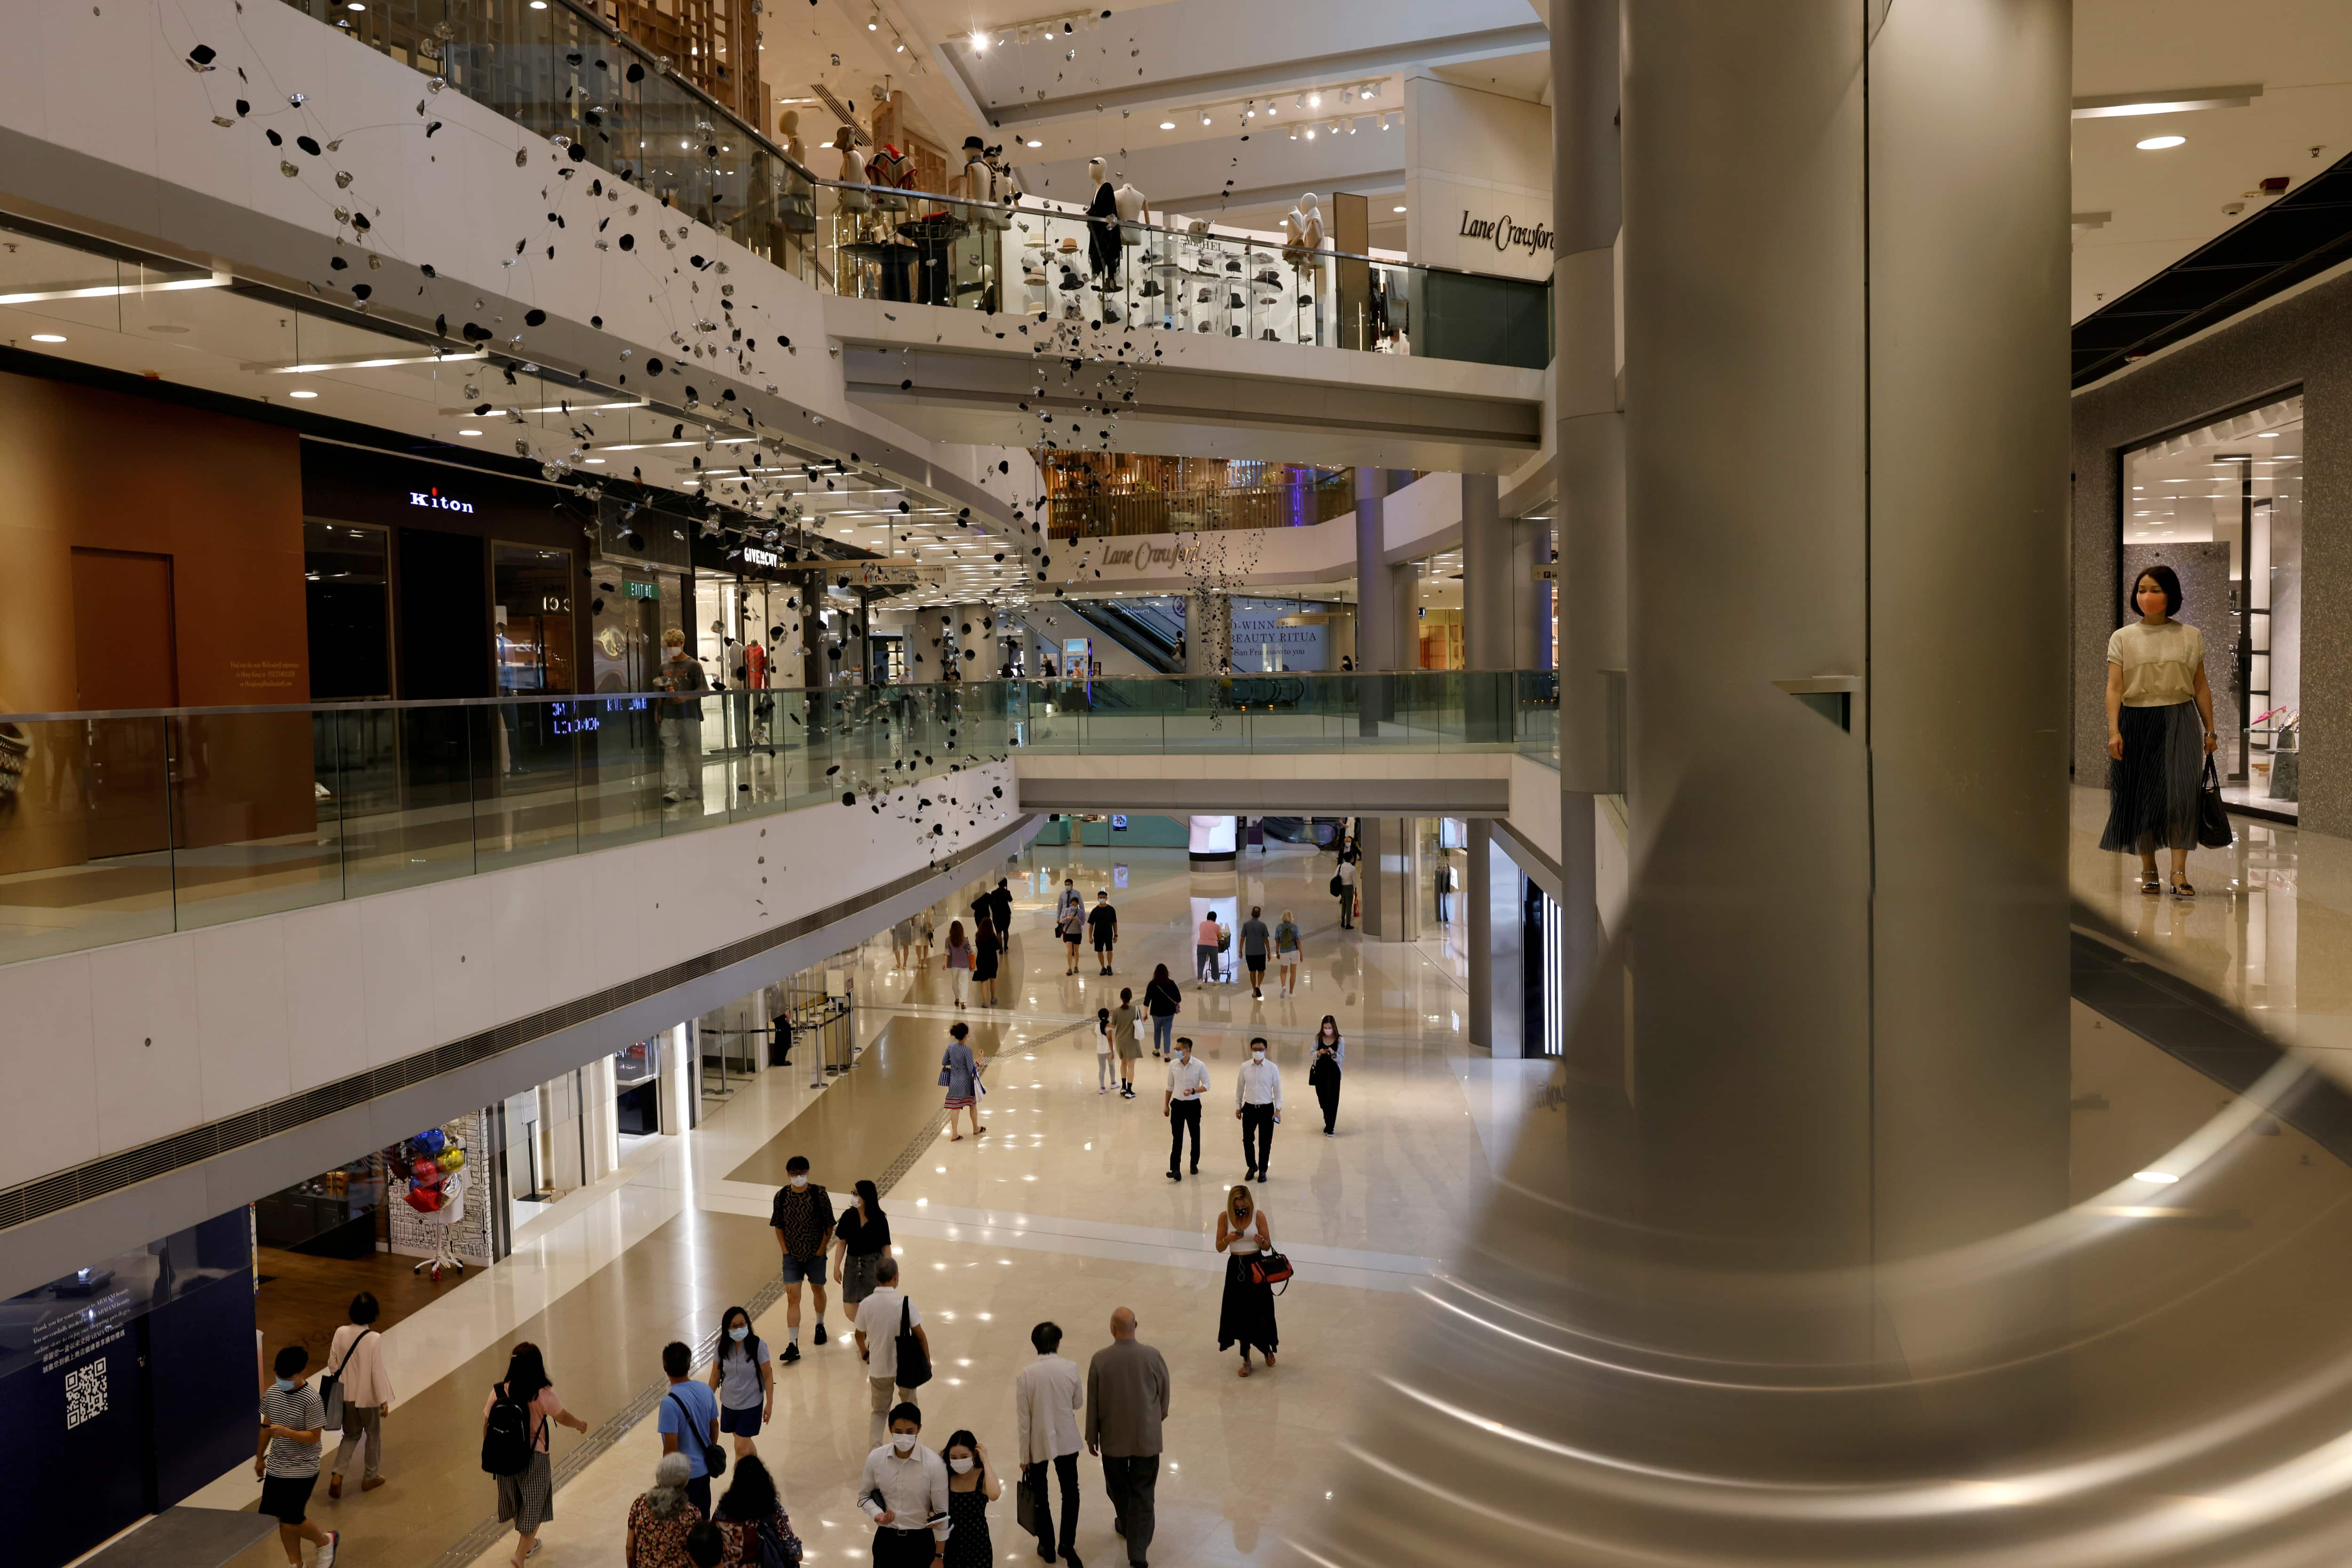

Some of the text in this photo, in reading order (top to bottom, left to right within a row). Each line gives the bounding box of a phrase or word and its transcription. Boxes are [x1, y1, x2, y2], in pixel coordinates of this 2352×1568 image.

[1459, 210, 1495, 239] Lane
[410, 487, 474, 513] Kiton
[744, 547, 777, 567] GIVENCHY
[1103, 541, 1200, 570] Lane Crawford
[631, 583, 643, 596] EXIT
[1231, 621, 1296, 629] D-WINN
[33, 1324, 47, 1334] Thank
[96, 1293, 115, 1305] ARMANI
[98, 1303, 116, 1315] ARMANI
[34, 1345, 49, 1355] online
